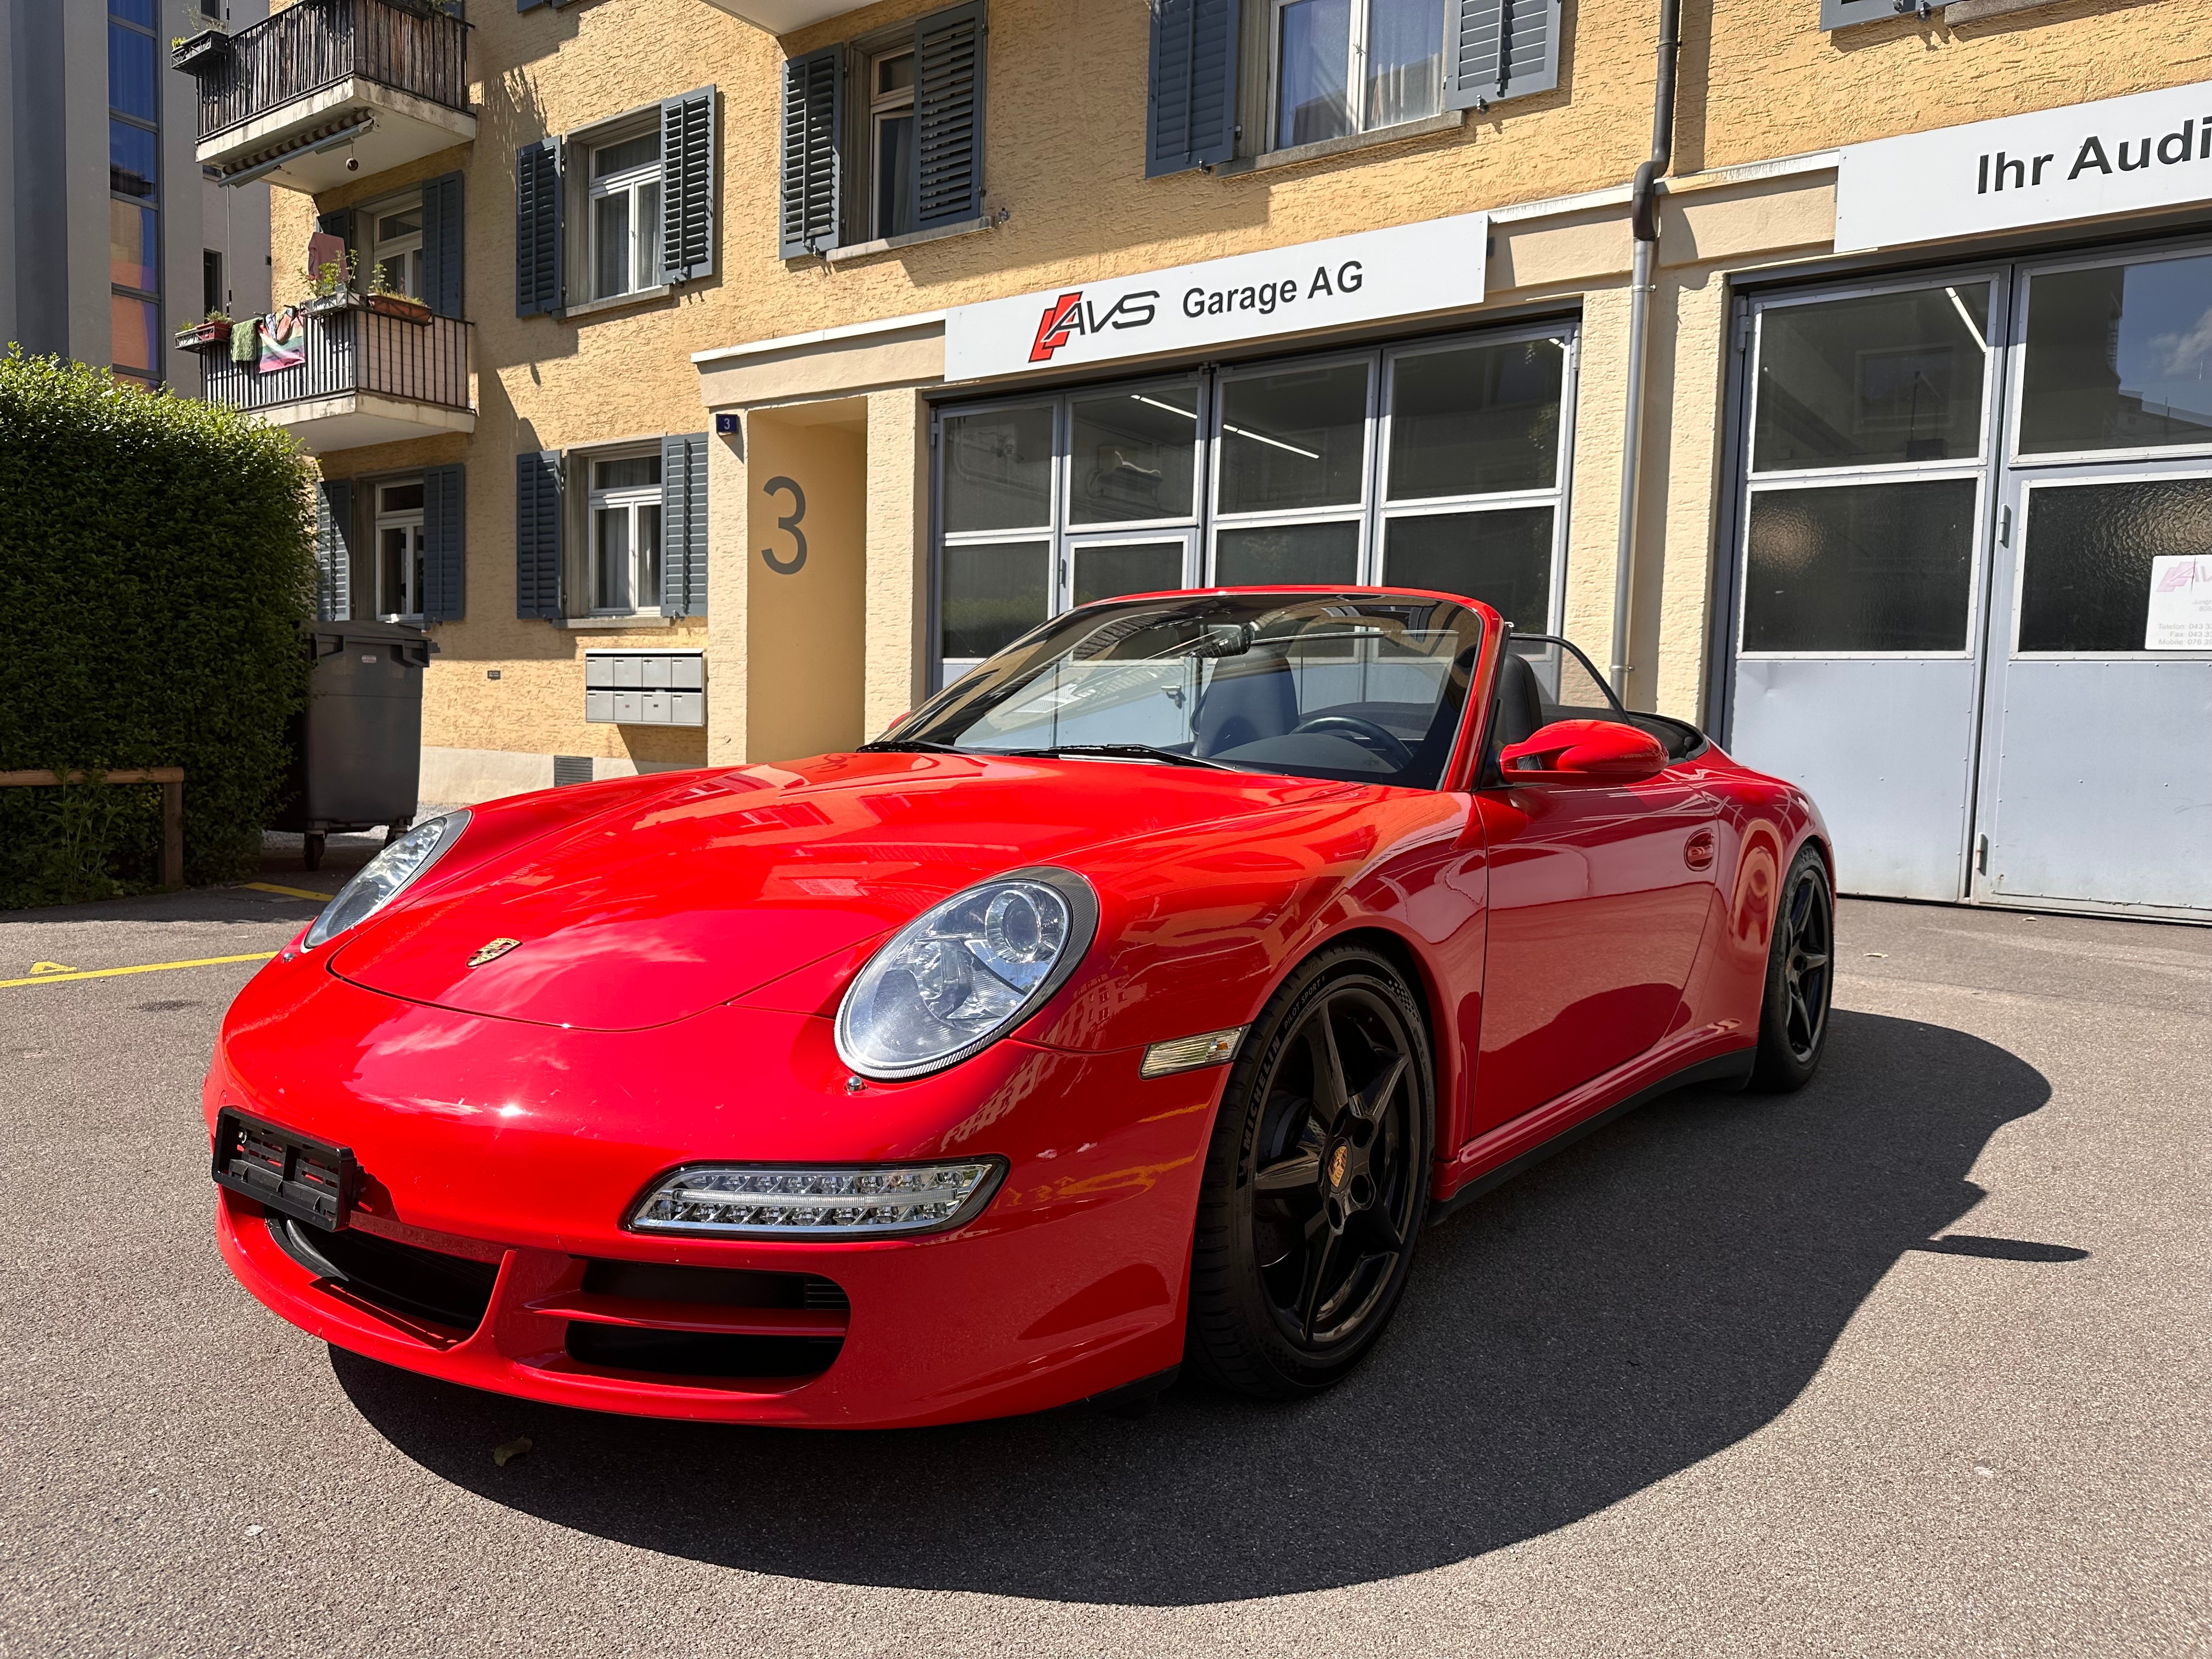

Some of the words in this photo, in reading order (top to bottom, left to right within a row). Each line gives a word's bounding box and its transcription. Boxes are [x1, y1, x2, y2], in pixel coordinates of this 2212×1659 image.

[1977, 151, 2055, 194] Ihr
[2067, 115, 2212, 180] Audi
[1042, 290, 1160, 341] AVS
[1182, 279, 1297, 318] Garage
[1307, 260, 1363, 300] AG
[724, 417, 731, 430] 3
[761, 476, 808, 575] 3
[1243, 1035, 1282, 1152] MICHELIN
[1284, 1001, 1300, 1030] PILOT
[1301, 978, 1321, 1005] SPORT
